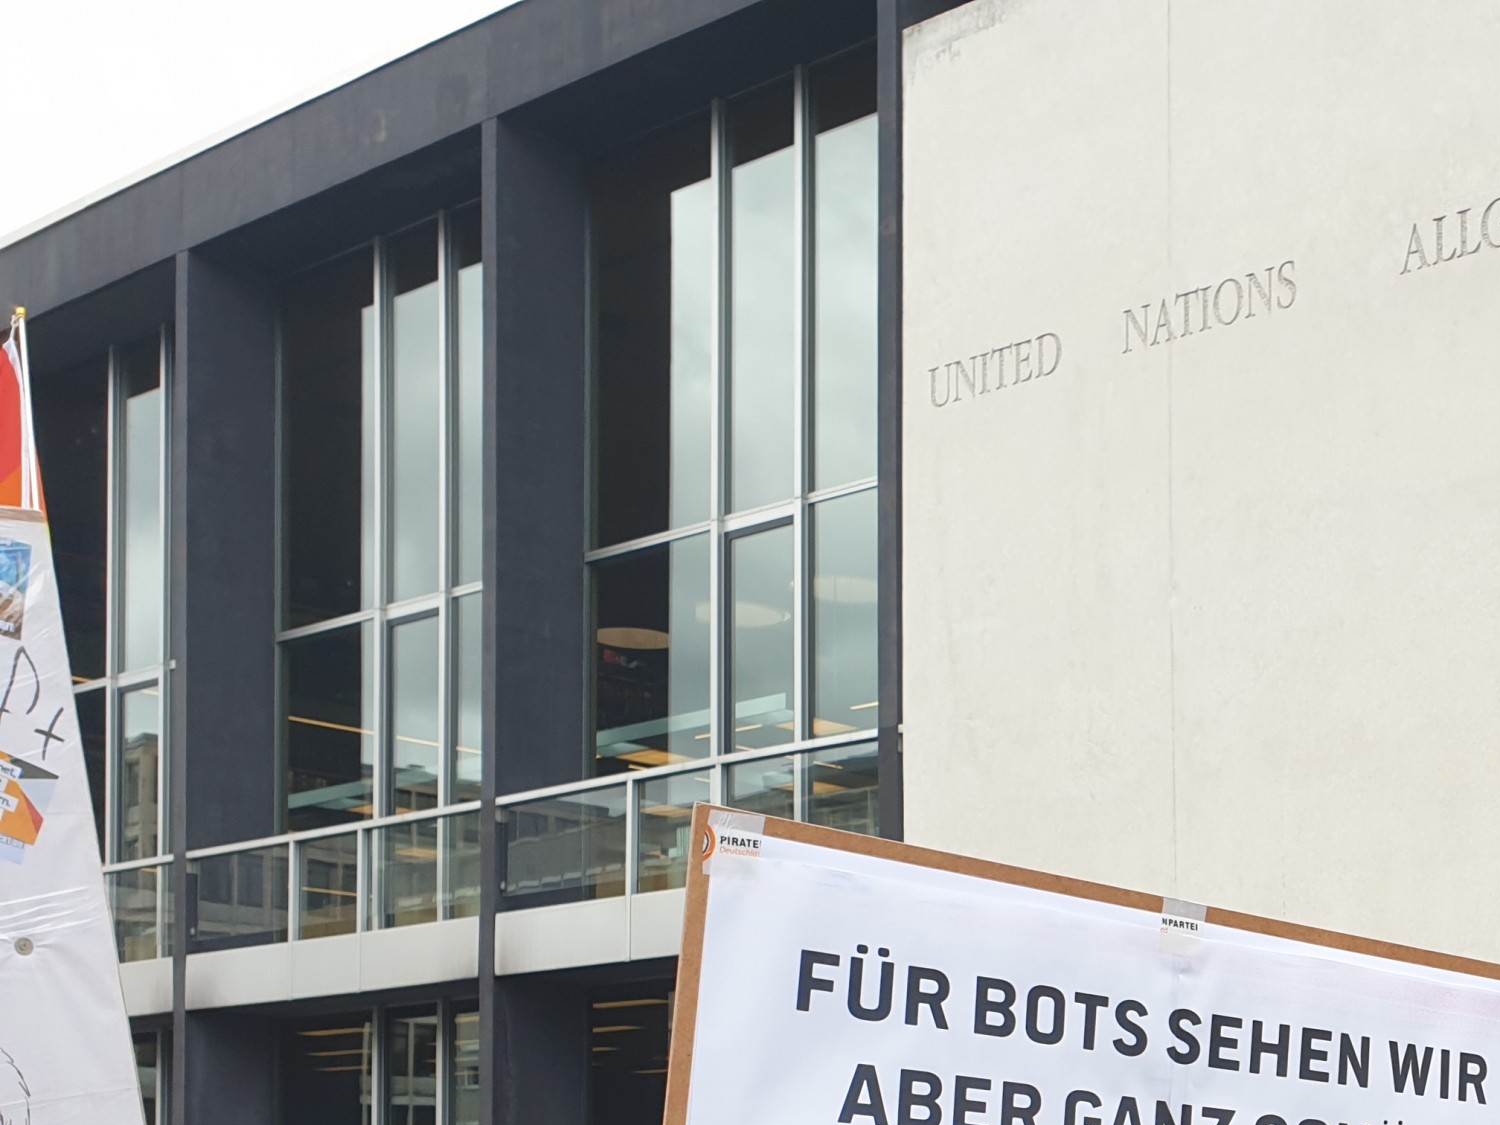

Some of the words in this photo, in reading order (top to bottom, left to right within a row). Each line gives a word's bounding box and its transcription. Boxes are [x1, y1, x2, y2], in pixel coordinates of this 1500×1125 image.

[928, 331, 1062, 408] UNITED
[1122, 260, 1297, 354] NATIONS
[795, 945, 949, 1030] FÜR
[973, 975, 1149, 1058] BOTS
[1166, 1008, 1370, 1088] SEHEN
[1387, 1040, 1489, 1105] WIR
